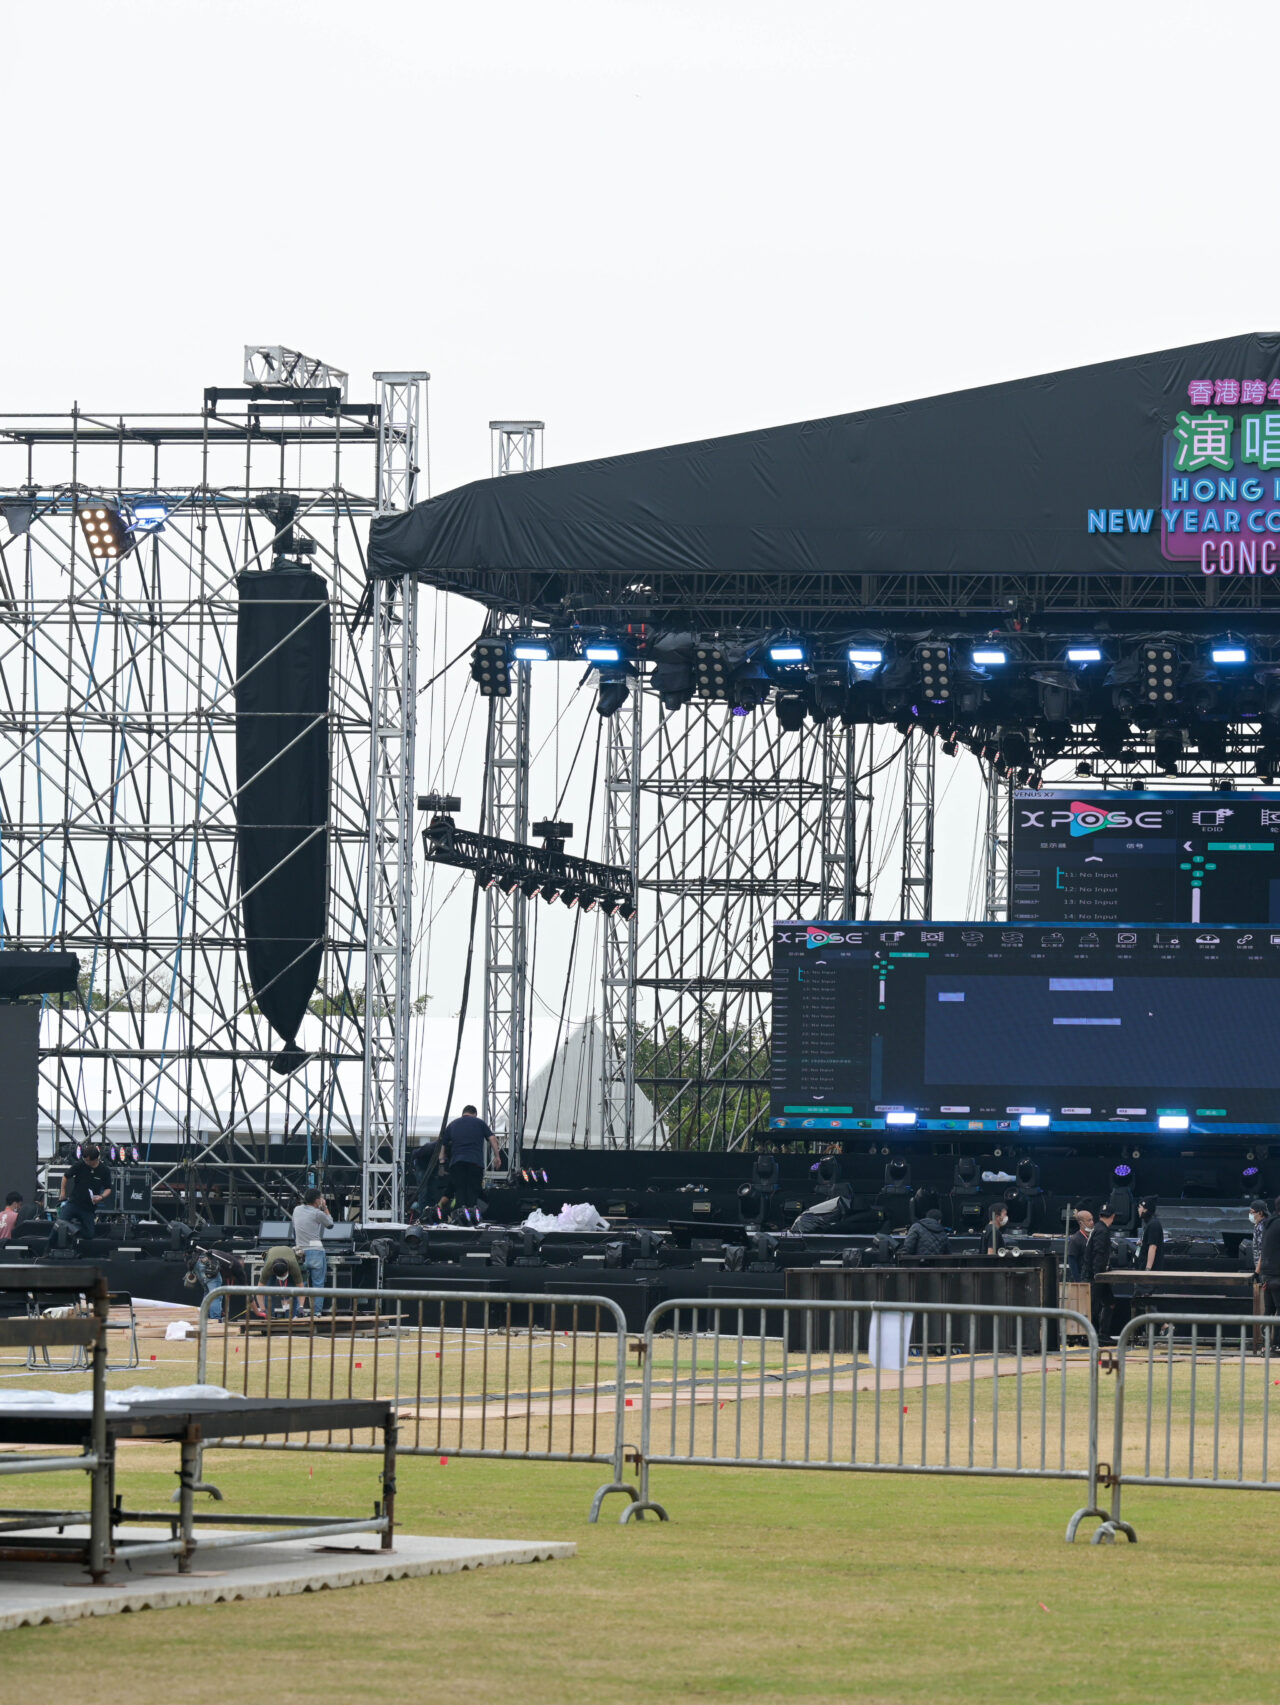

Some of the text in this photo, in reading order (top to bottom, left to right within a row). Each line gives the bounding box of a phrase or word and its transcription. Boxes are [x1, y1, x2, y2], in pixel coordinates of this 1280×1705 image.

[1171, 478, 1264, 502] HONG
[1087, 509, 1154, 533] NEW
[1161, 509, 1241, 533] YEAR
[1021, 811, 1163, 828] XPOSE
[777, 932, 862, 944] XPOSE
